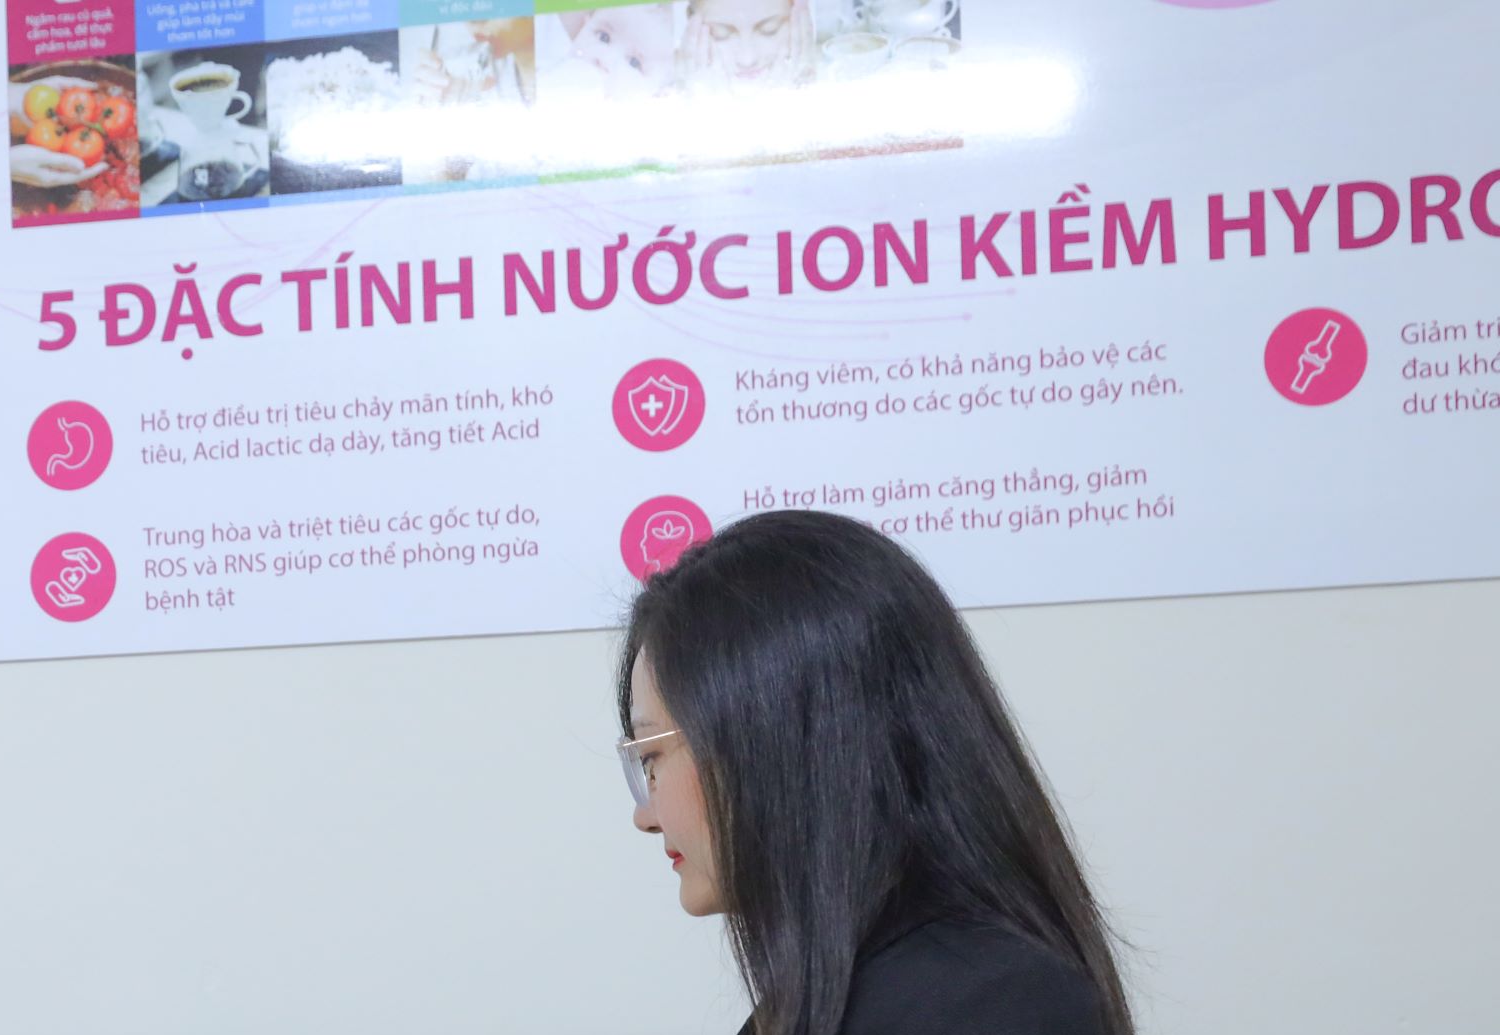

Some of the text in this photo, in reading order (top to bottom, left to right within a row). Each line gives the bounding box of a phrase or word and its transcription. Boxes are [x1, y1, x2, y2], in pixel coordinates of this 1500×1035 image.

[38, 291, 78, 351] 5
[99, 261, 264, 360] ĐẶC
[280, 251, 475, 332] TÍNH
[502, 224, 750, 317] NƯỚC
[776, 219, 929, 295] ION
[959, 183, 1177, 281] KIỀM
[1401, 320, 1467, 345] Giảm
[735, 340, 1167, 392] Kháng viêm, có khả năng bảo vệ các
[1402, 356, 1449, 380] đau
[140, 385, 554, 433] Hỗ trợ điều trị tiêu chảy mãn tính, khó
[736, 373, 1184, 424] tổn thương do các gốc tự do gây nên.
[1403, 392, 1437, 415] dư
[141, 418, 539, 465] tiêu, Acid lactic dạ dày, tăng tiết Acid
[744, 464, 1148, 511] Hỗ trợ làm giảm căng thẳng, giảm
[143, 504, 540, 549] Trung hòa và triệt tiêu các gốc tự do,
[881, 516, 909, 535] cơ
[915, 506, 955, 533] thể
[961, 508, 1003, 530] thư
[1008, 505, 1060, 533] giãn
[1068, 501, 1129, 529] phục
[1137, 494, 1175, 519] hồi
[144, 537, 539, 579] ROS và RNS giúp cơ thể phòng ngừa
[145, 586, 235, 615] bệnh tật
